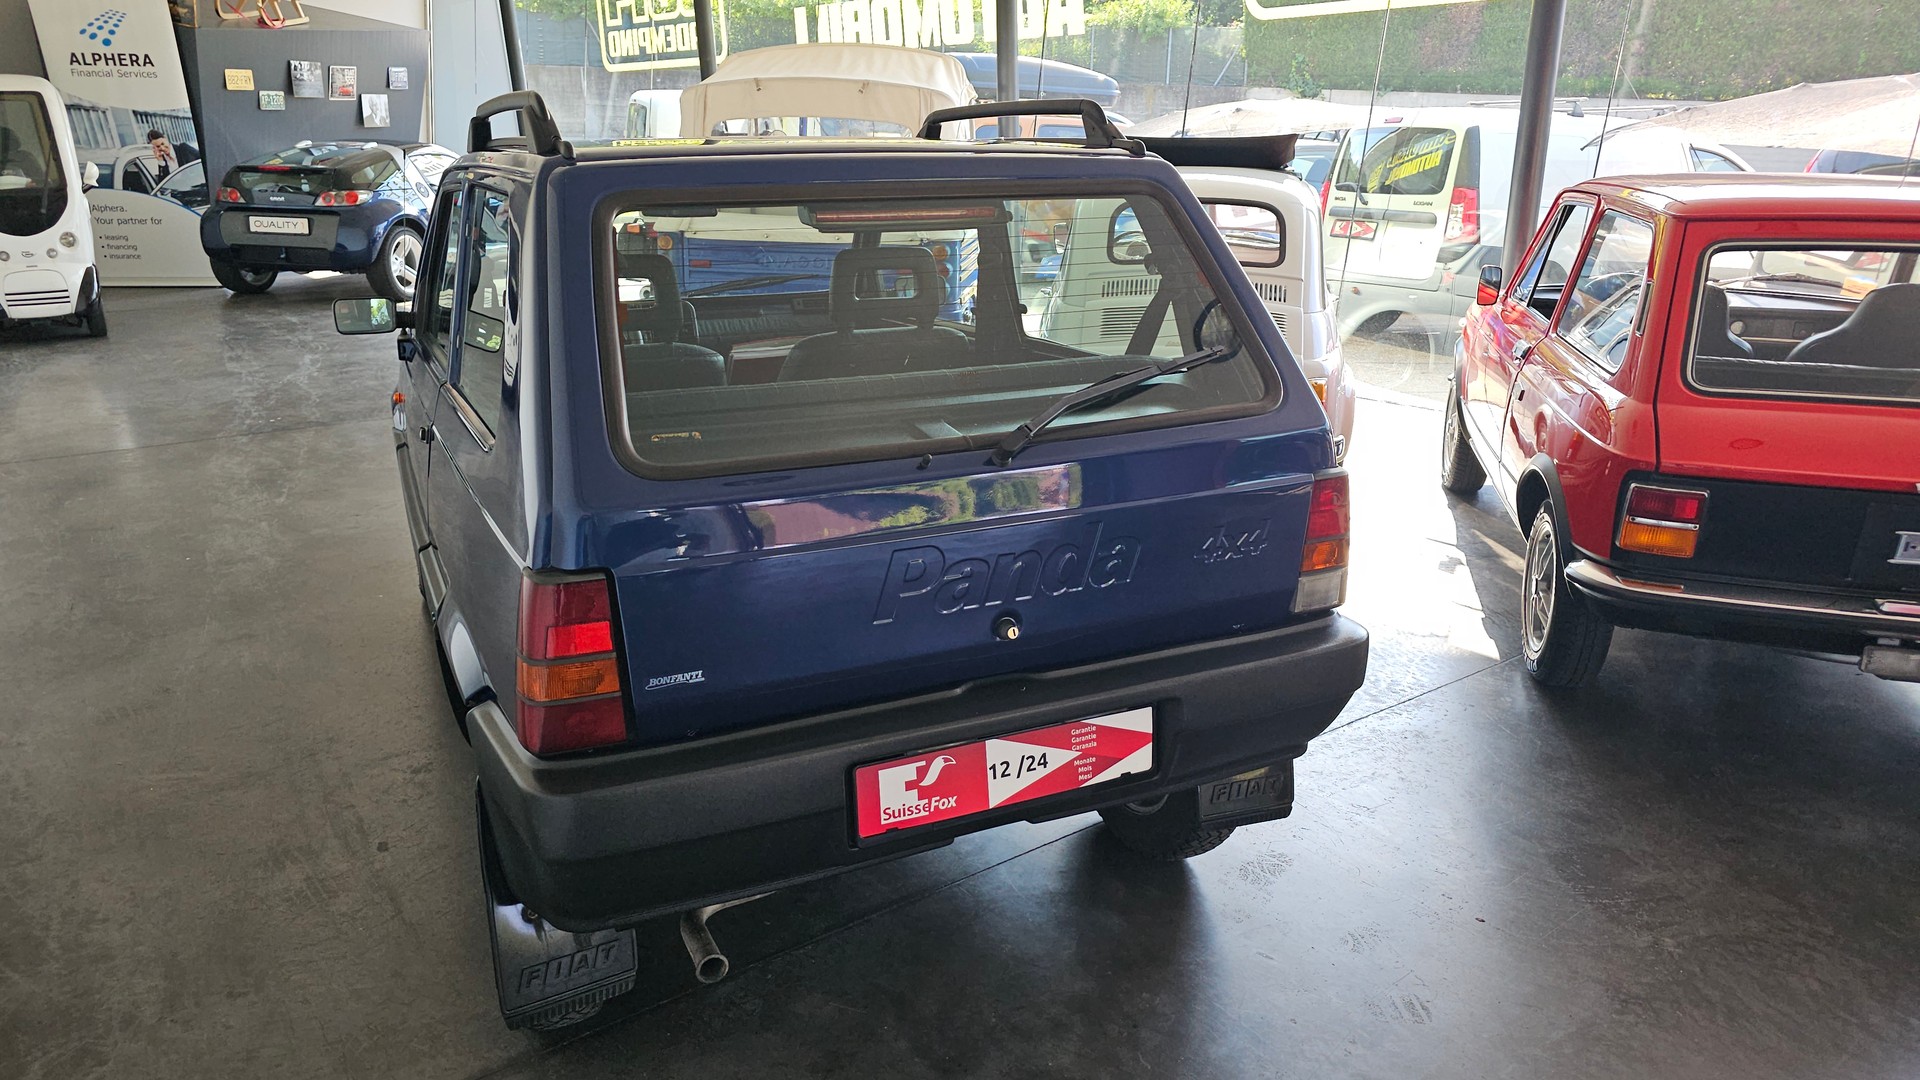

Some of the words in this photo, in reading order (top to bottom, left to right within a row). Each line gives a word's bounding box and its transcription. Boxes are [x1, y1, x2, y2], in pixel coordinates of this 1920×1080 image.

[69, 52, 155, 67] ALPHERA
[70, 68, 114, 78] Financial
[116, 69, 158, 79] Services
[91, 203, 128, 213] Alphera.
[94, 217, 114, 225] Your
[117, 217, 148, 226] partner
[150, 216, 163, 225] for
[104, 234, 129, 242] leasing
[106, 243, 138, 251] financing
[109, 252, 142, 260] insurance
[1194, 517, 1271, 563] 4x4
[872, 521, 1142, 624] Panda
[648, 670, 703, 686] BONFANTI
[1071, 725, 1097, 735] Garantie
[1071, 733, 1097, 743] Garantie
[1071, 741, 1097, 751] Garanzia
[1073, 757, 1096, 767] Monate
[1078, 765, 1093, 773] Mois
[1078, 772, 1093, 781] Mesi
[1211, 775, 1280, 803] FIAT
[519, 940, 619, 992] FIAT
